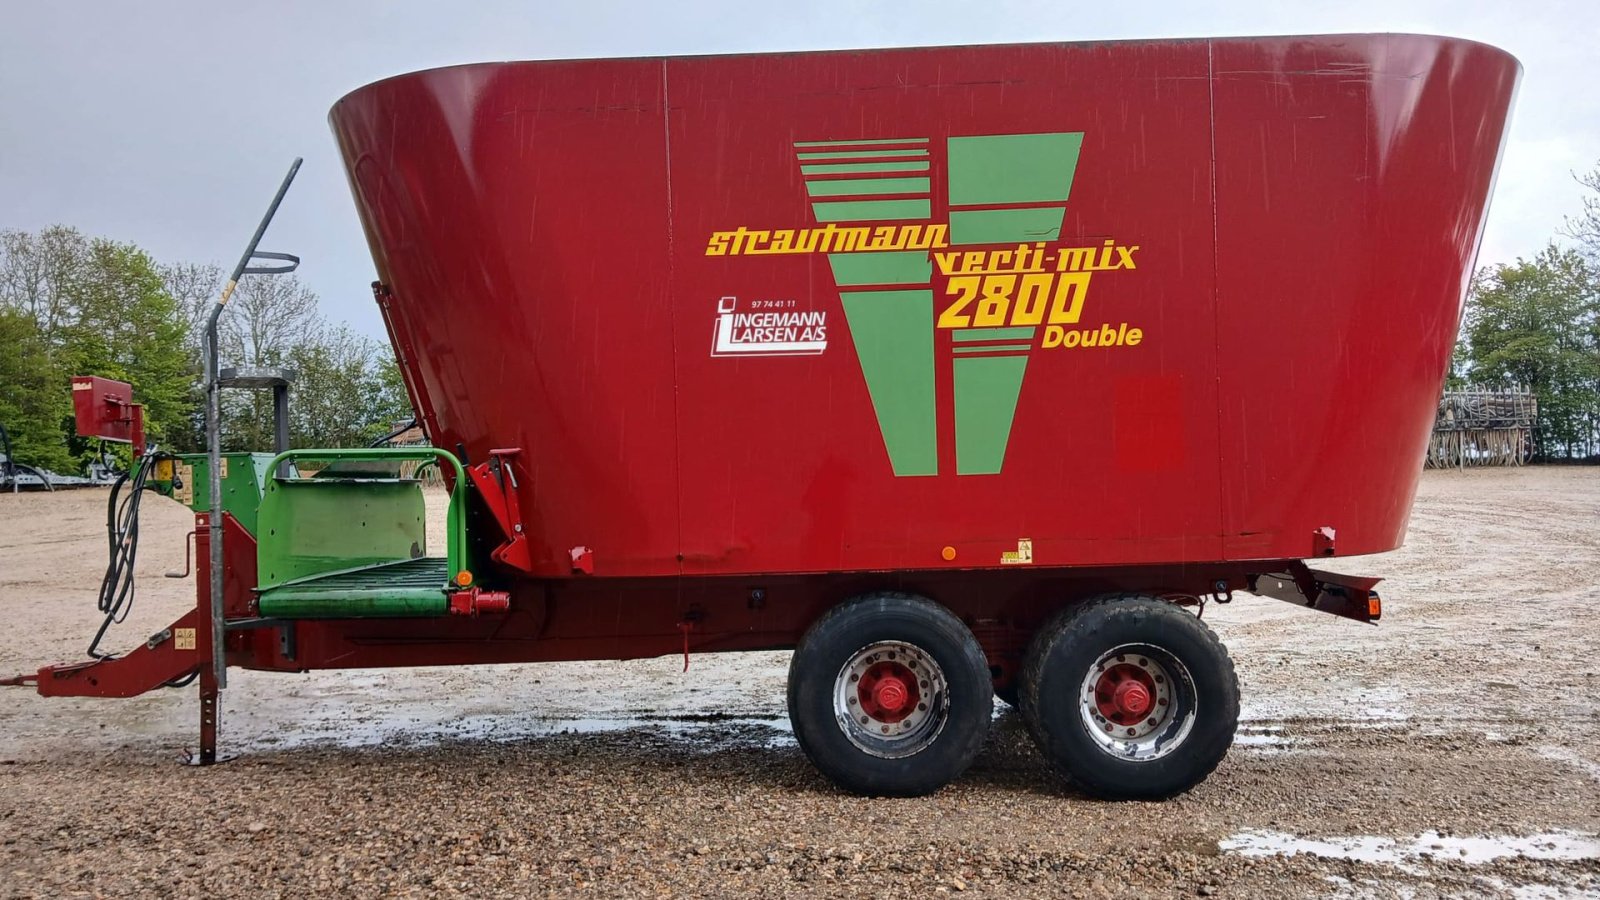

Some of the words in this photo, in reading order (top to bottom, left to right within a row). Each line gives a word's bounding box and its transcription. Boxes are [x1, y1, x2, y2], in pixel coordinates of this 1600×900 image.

[705, 224, 948, 256] strautmann
[935, 240, 1139, 275] verti-mix
[751, 300, 762, 308] 97
[763, 300, 773, 308] 74
[774, 300, 784, 308] 41
[937, 272, 1091, 328] 2800
[733, 311, 826, 328] INGEMANN
[731, 327, 798, 343] LARSEN
[799, 326, 826, 342] A/S
[1041, 324, 1142, 349] Double
